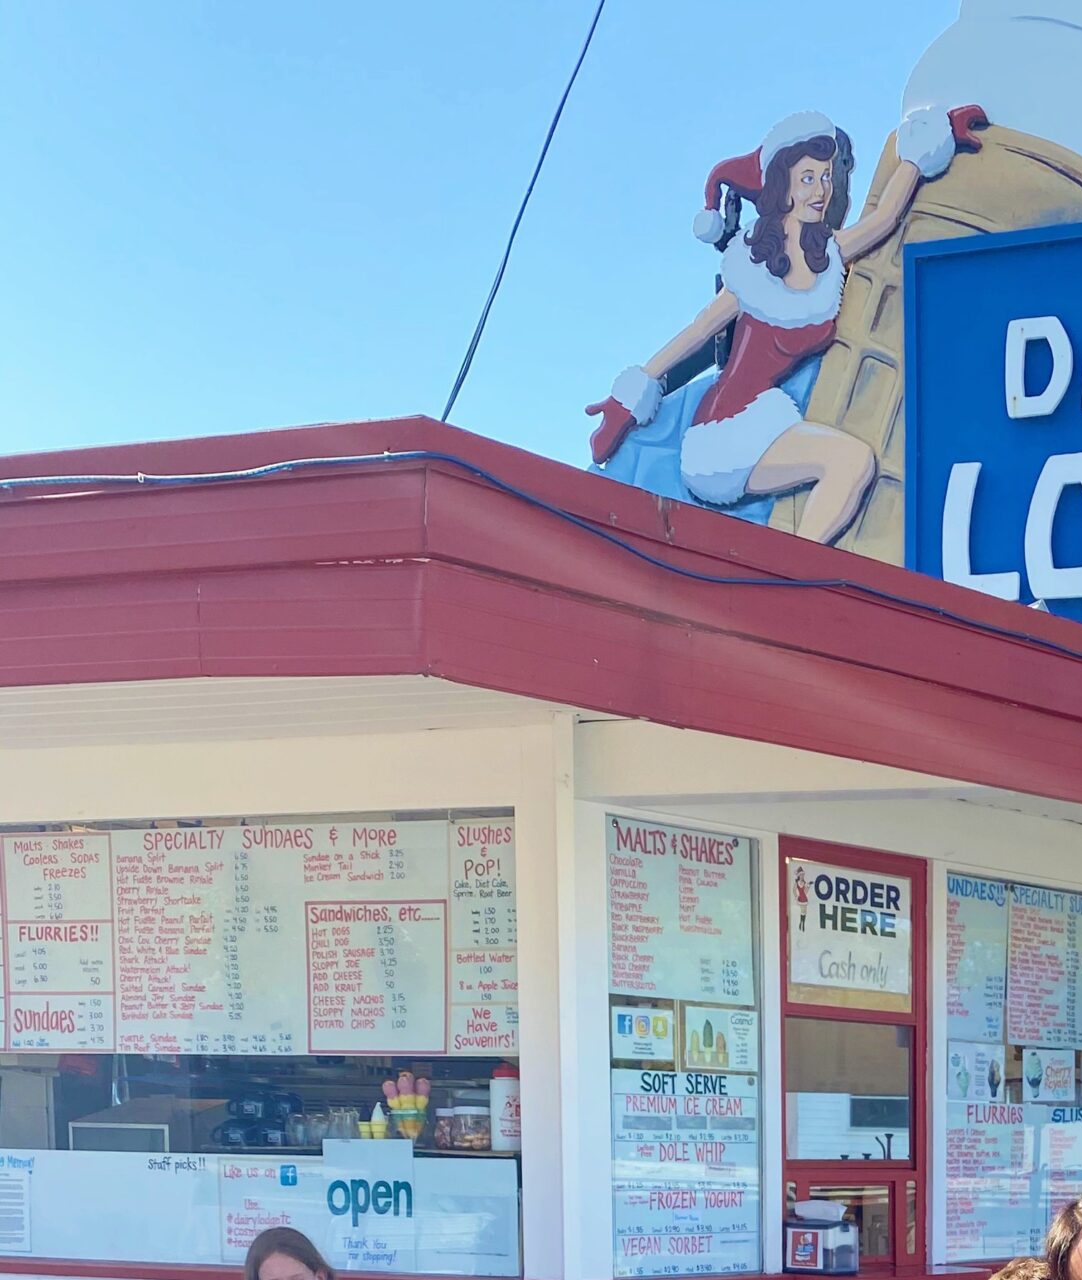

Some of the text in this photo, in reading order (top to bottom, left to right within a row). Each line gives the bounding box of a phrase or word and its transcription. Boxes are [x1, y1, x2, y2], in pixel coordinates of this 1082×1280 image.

[616, 825, 733, 866] MALTS & SHAKES
[814, 874, 901, 911] ORDER
[1013, 886, 1065, 913] SPECIALTY
[819, 904, 896, 938] HERE
[19, 925, 98, 942] FLURRIES!!
[456, 953, 514, 964] Bottled Water
[818, 950, 889, 988] Cash only
[13, 1001, 75, 1033] Sundaes
[314, 1019, 376, 1029] POTATO CHIPS
[472, 1008, 491, 1020] We
[467, 1019, 497, 1034] Have
[455, 1030, 515, 1050] Souvenirs!
[641, 1072, 728, 1095] SOFT SERVE
[625, 1095, 743, 1116] PREMIUM ICE CREAM
[659, 1142, 726, 1163] DOLE WHIP
[148, 1156, 206, 1174] Staff picks!!
[223, 1165, 276, 1179] Like us on
[327, 1179, 413, 1227] open
[649, 1191, 696, 1211] FROZEN
[704, 1190, 744, 1209] YOGURT
[342, 1237, 387, 1249] Thank You
[622, 1235, 713, 1257] VEGAN SORBET
[362, 1250, 397, 1266] stopping!
